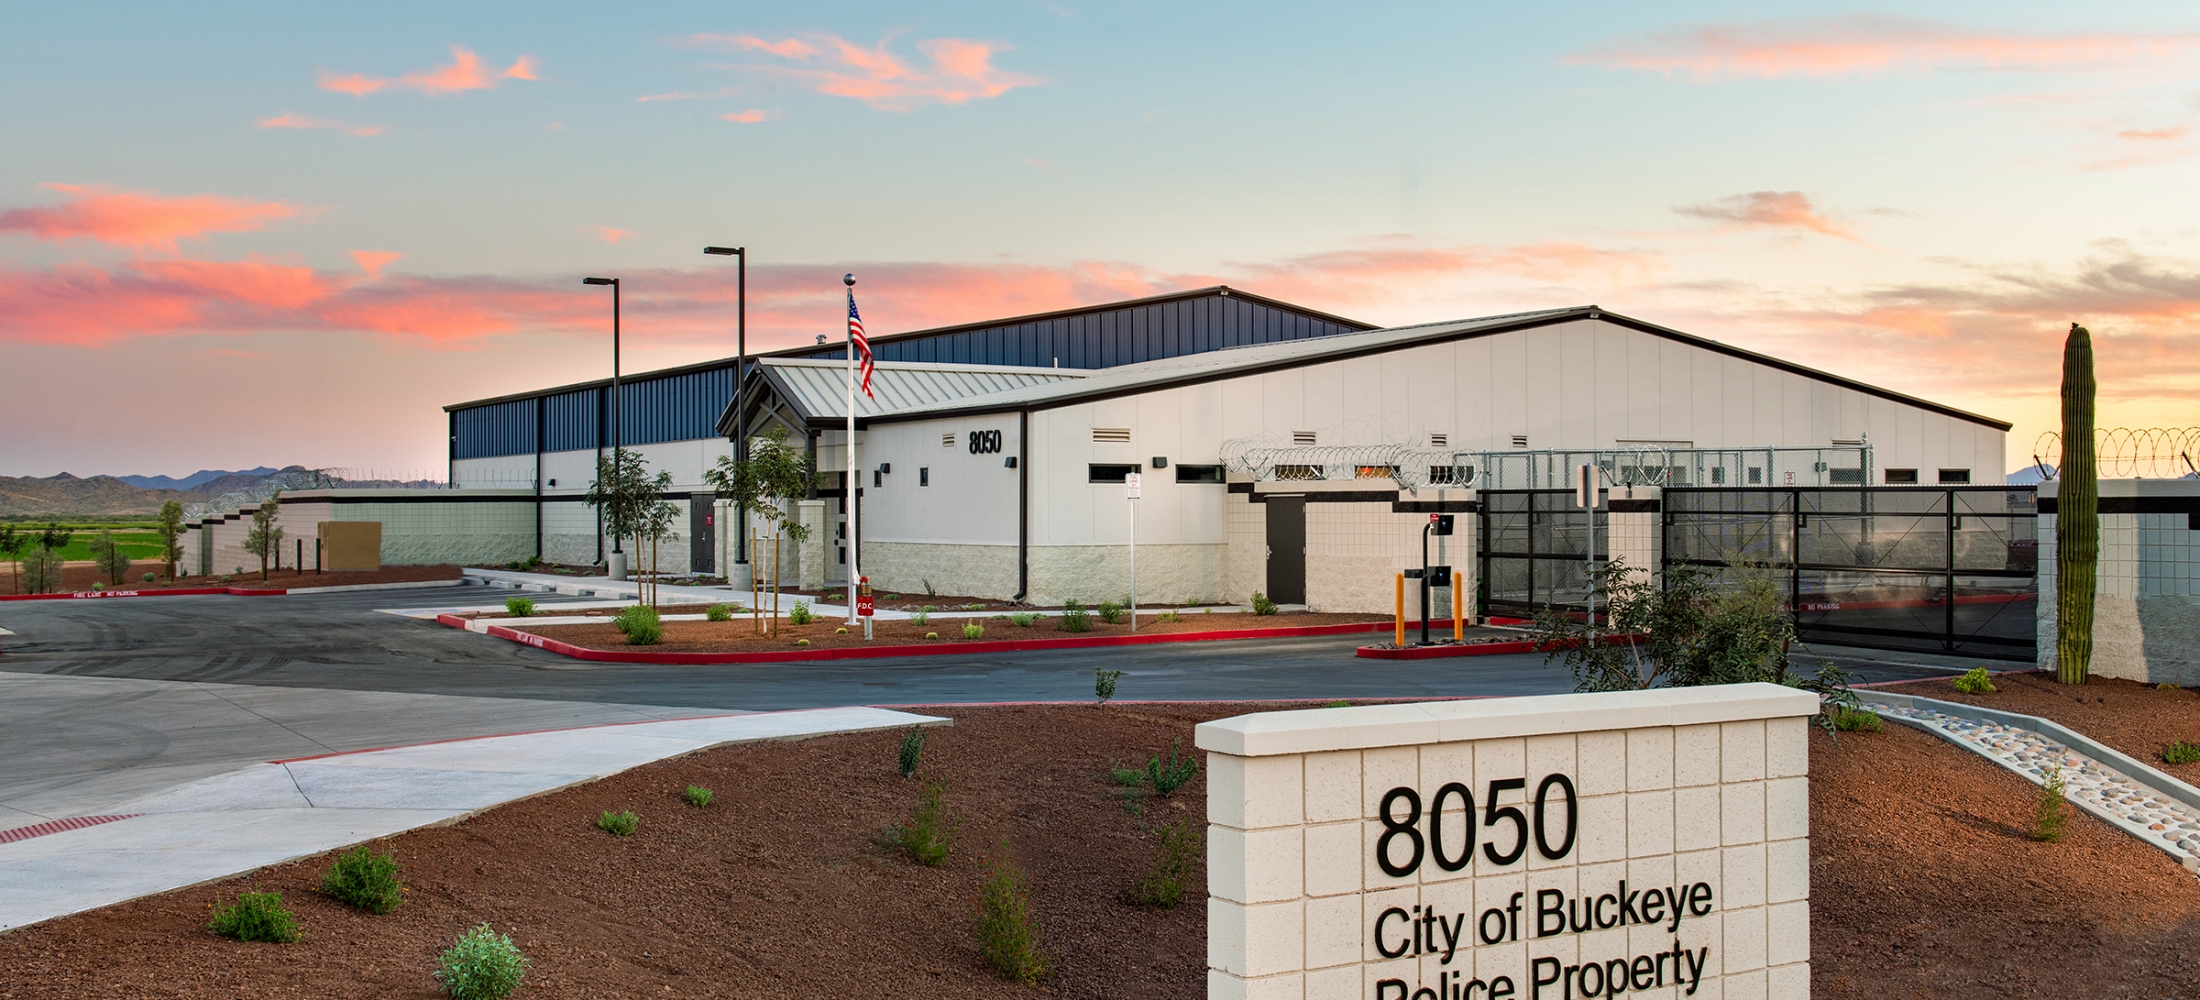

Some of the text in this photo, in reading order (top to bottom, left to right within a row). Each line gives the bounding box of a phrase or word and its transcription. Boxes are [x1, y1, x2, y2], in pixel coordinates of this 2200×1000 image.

[969, 429, 1002, 454] 8050
[1376, 772, 1578, 878] 8050
[1374, 879, 1713, 966] City of Buckeye
[1531, 939, 1709, 1000] Property
